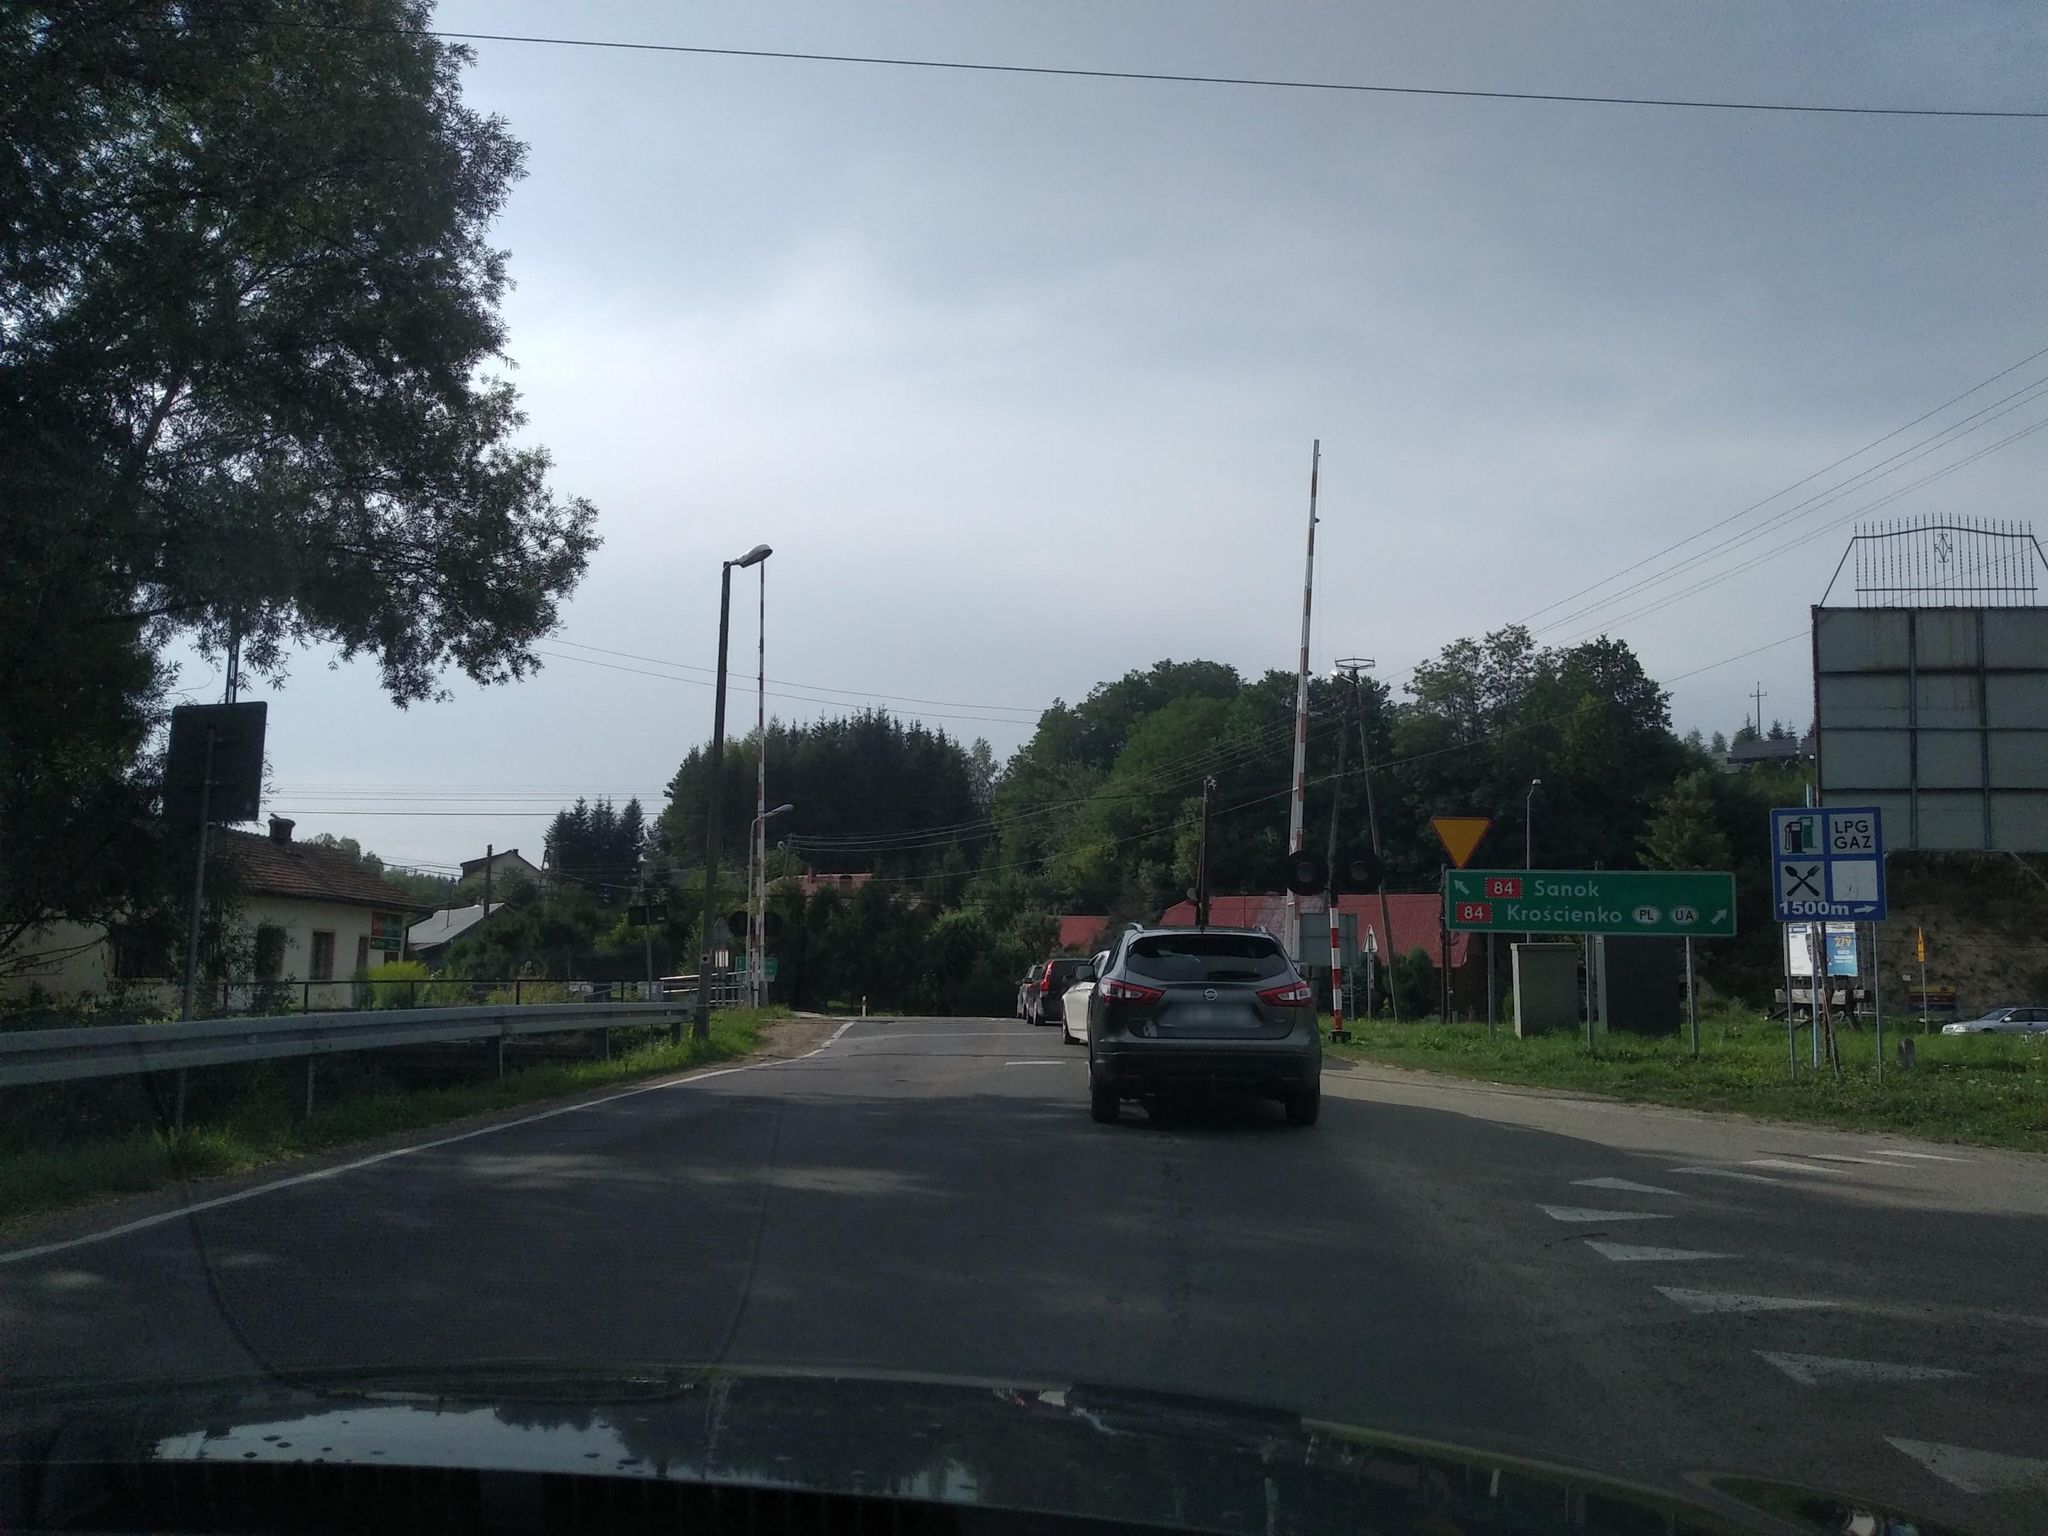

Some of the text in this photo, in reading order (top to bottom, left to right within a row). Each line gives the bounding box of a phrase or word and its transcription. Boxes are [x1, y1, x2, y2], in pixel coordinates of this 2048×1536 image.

[1834, 819, 1868, 834] LPG
[1834, 835, 1872, 849] GAZ
[1493, 879, 1600, 898] 84 Sanok
[1463, 904, 1694, 924] 84 Krościenko PL UA
[1779, 901, 1849, 916] 1500m
